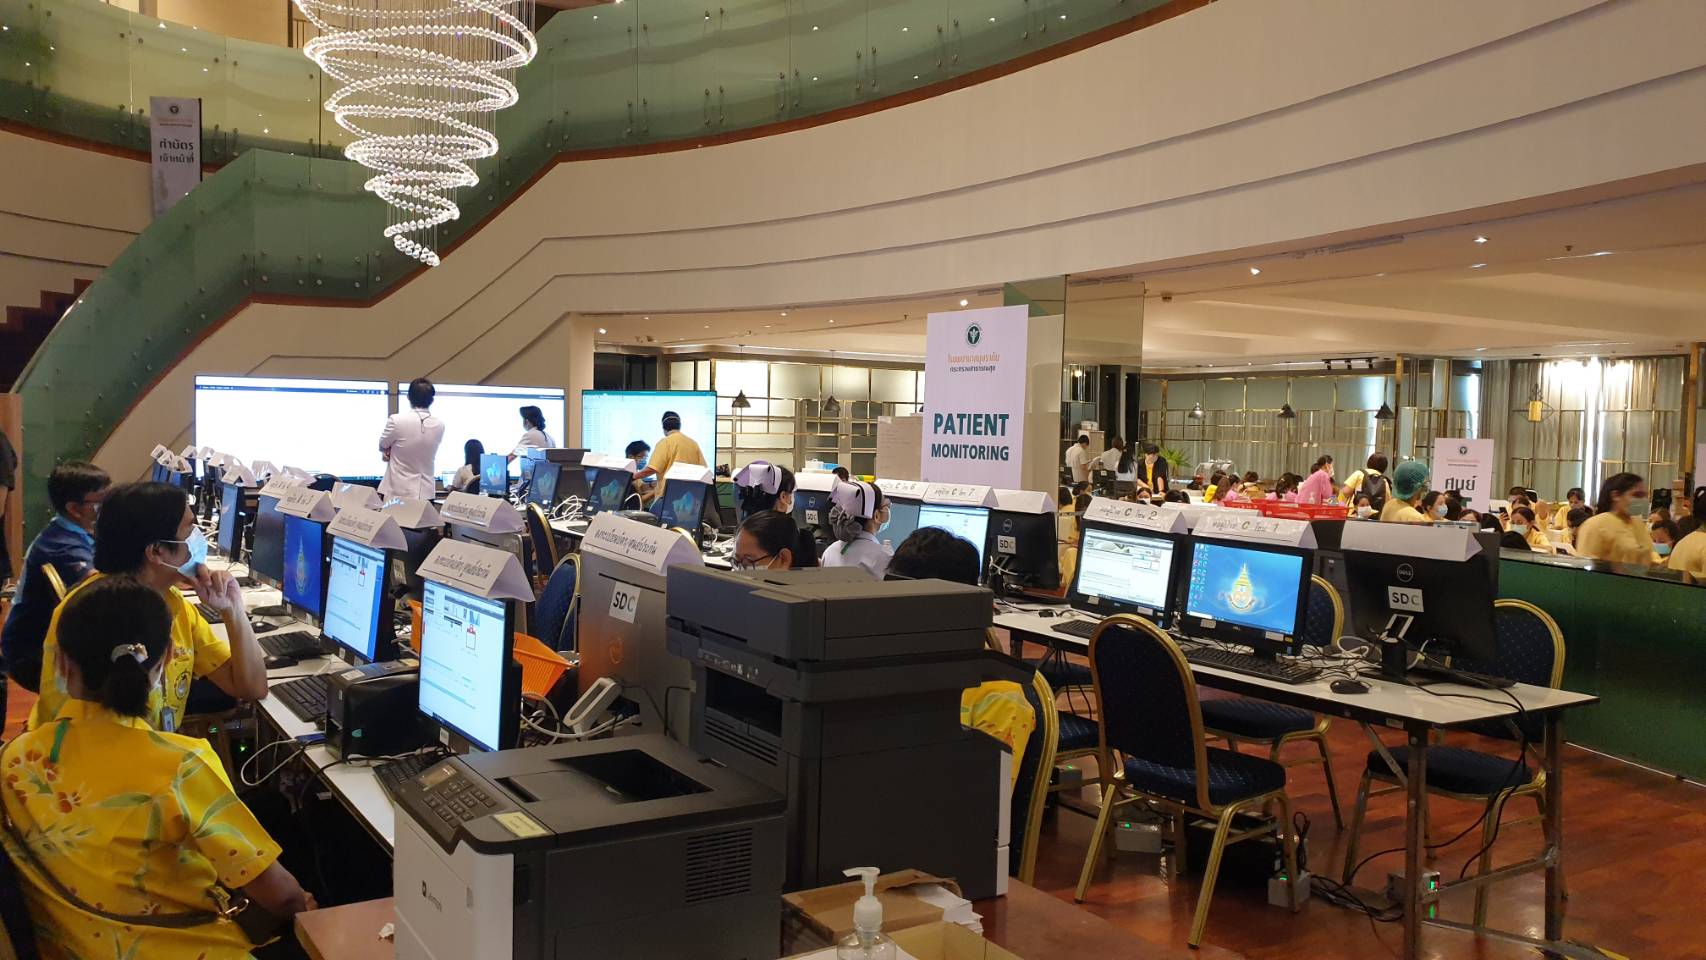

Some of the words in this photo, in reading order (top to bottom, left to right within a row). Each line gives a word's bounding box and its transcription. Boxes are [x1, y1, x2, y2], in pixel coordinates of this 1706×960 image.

[933, 413, 1010, 436] PATIENT
[931, 443, 1009, 461] MONITORING
[1444, 475, 1478, 491] ศนย์
[1124, 507, 1133, 517] C
[1148, 510, 1158, 521] 2
[1241, 520, 1251, 530] C
[613, 591, 636, 612] SDC
[1391, 591, 1421, 606] SDC
